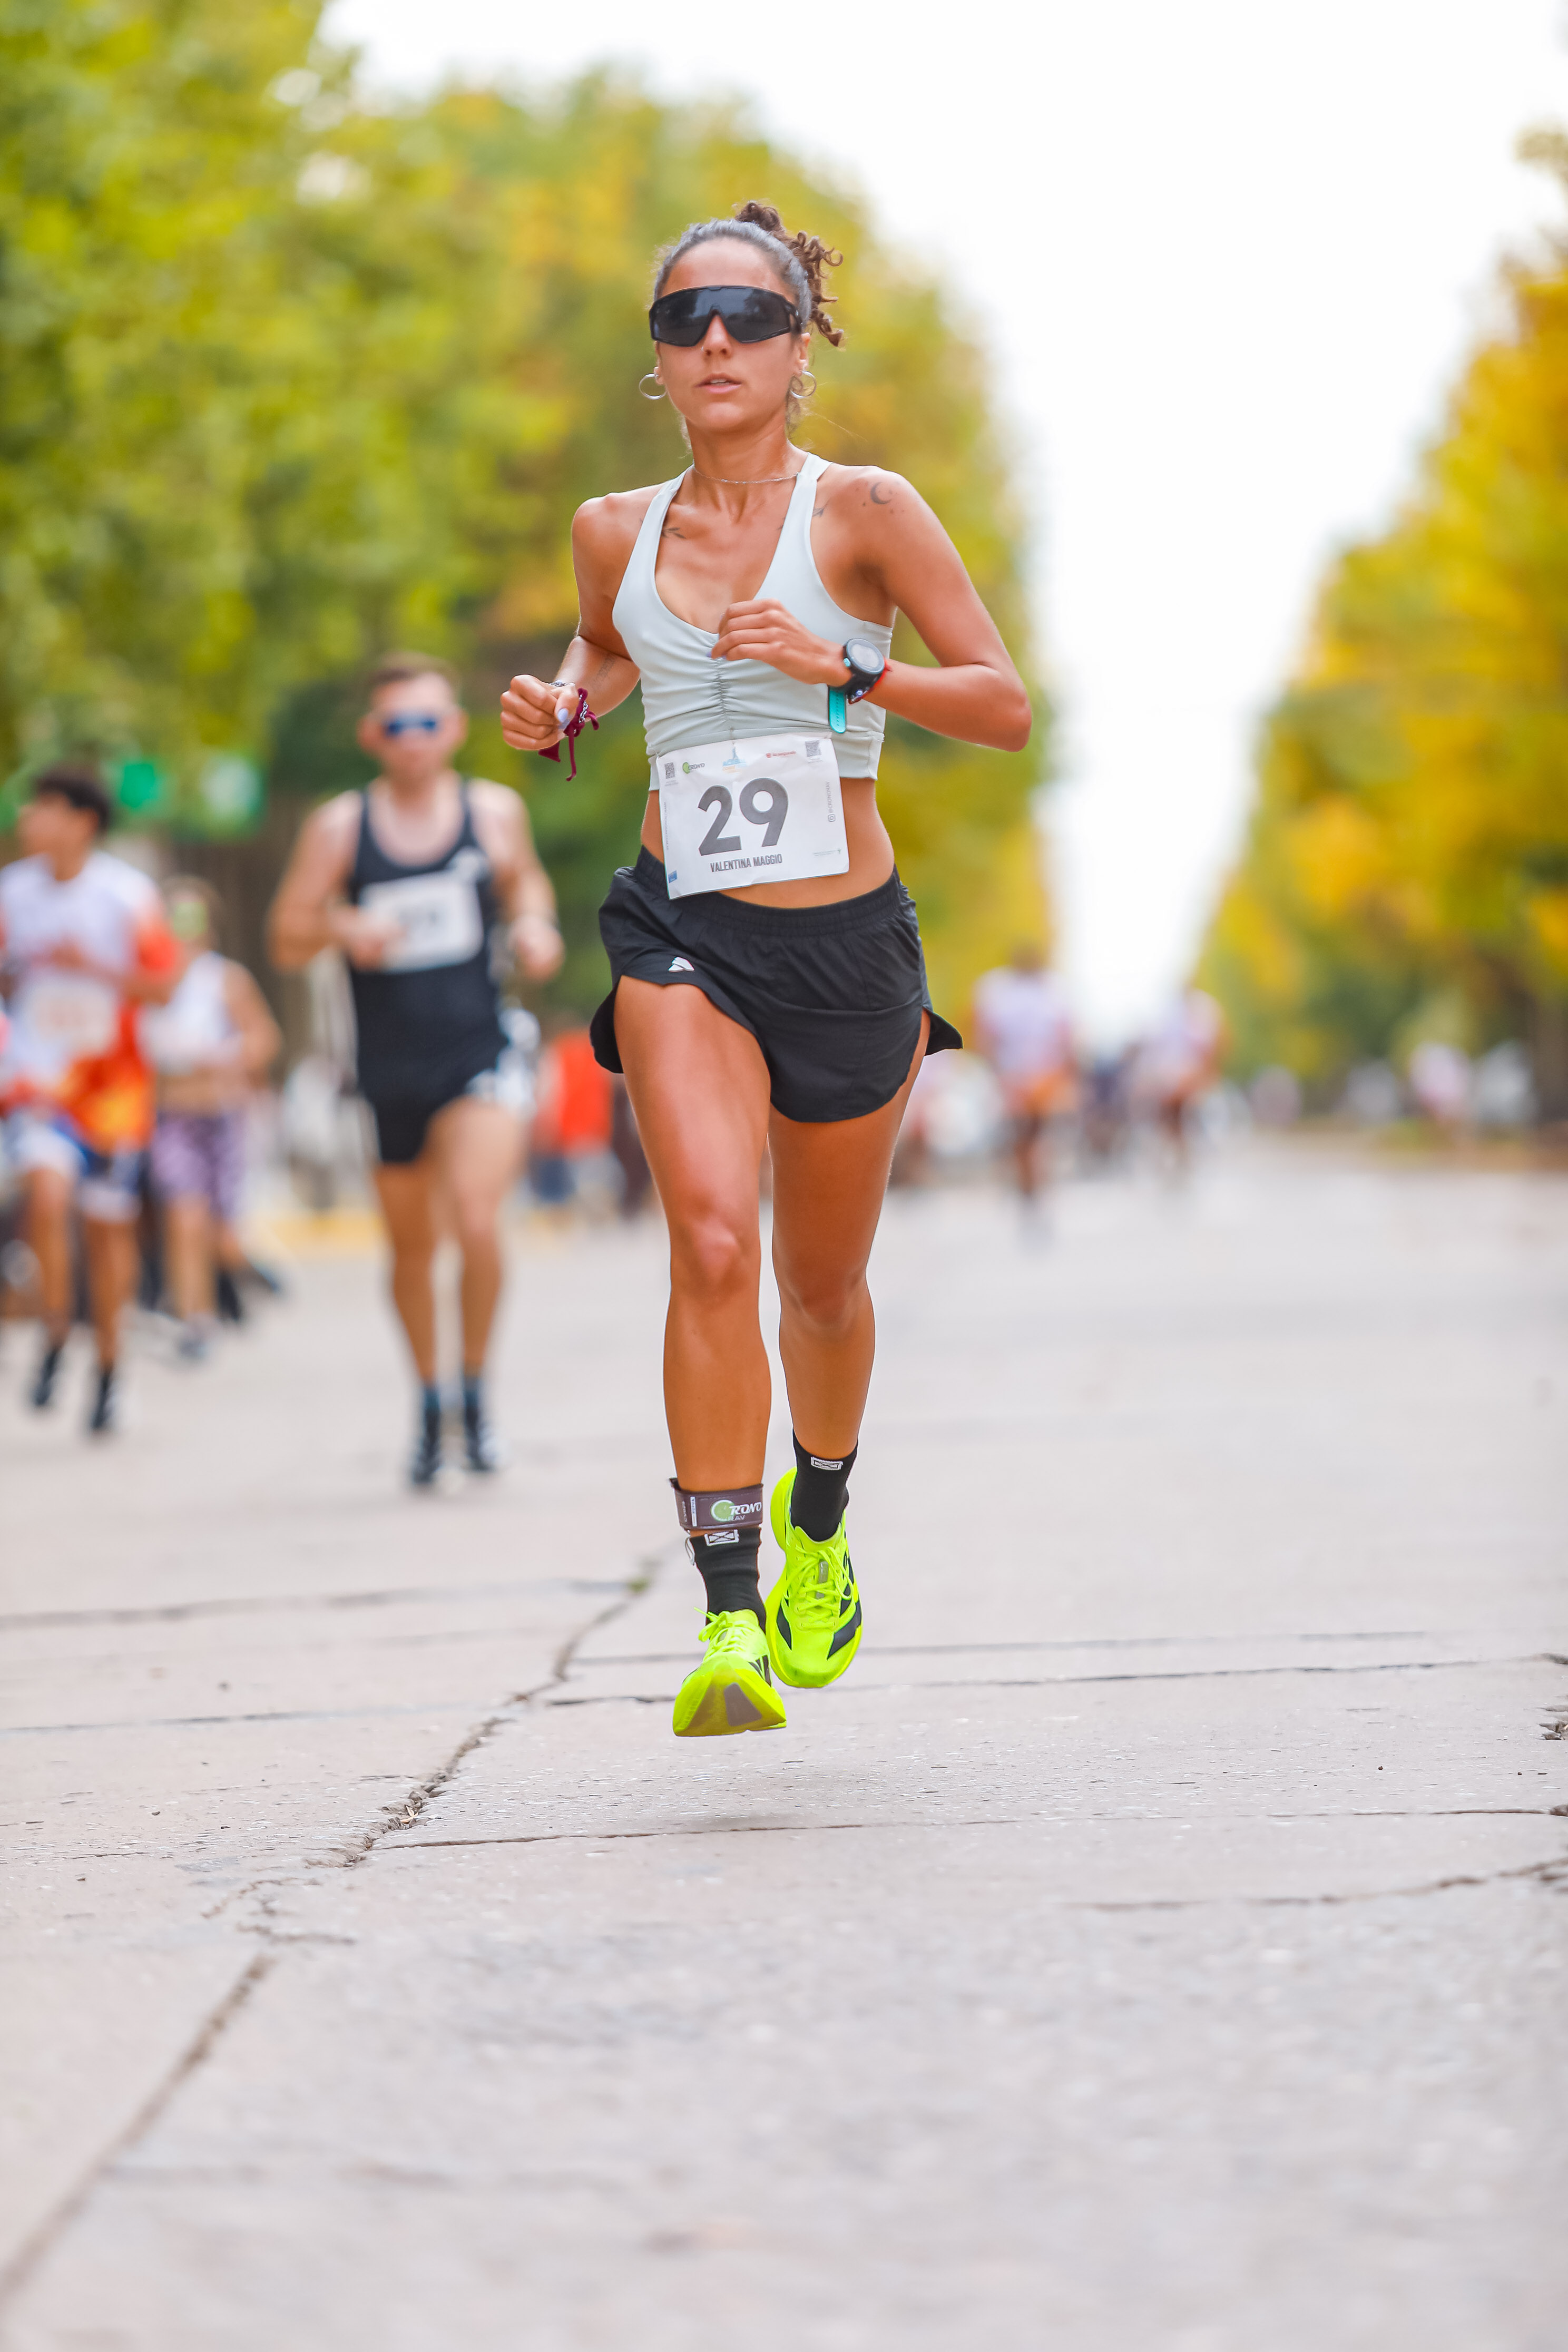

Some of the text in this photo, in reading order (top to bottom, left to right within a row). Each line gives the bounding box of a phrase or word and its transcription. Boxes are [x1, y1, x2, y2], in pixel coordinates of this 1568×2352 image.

[698, 777, 788, 856] 29
[710, 854, 783, 873] VALENTINA MAGGIO
